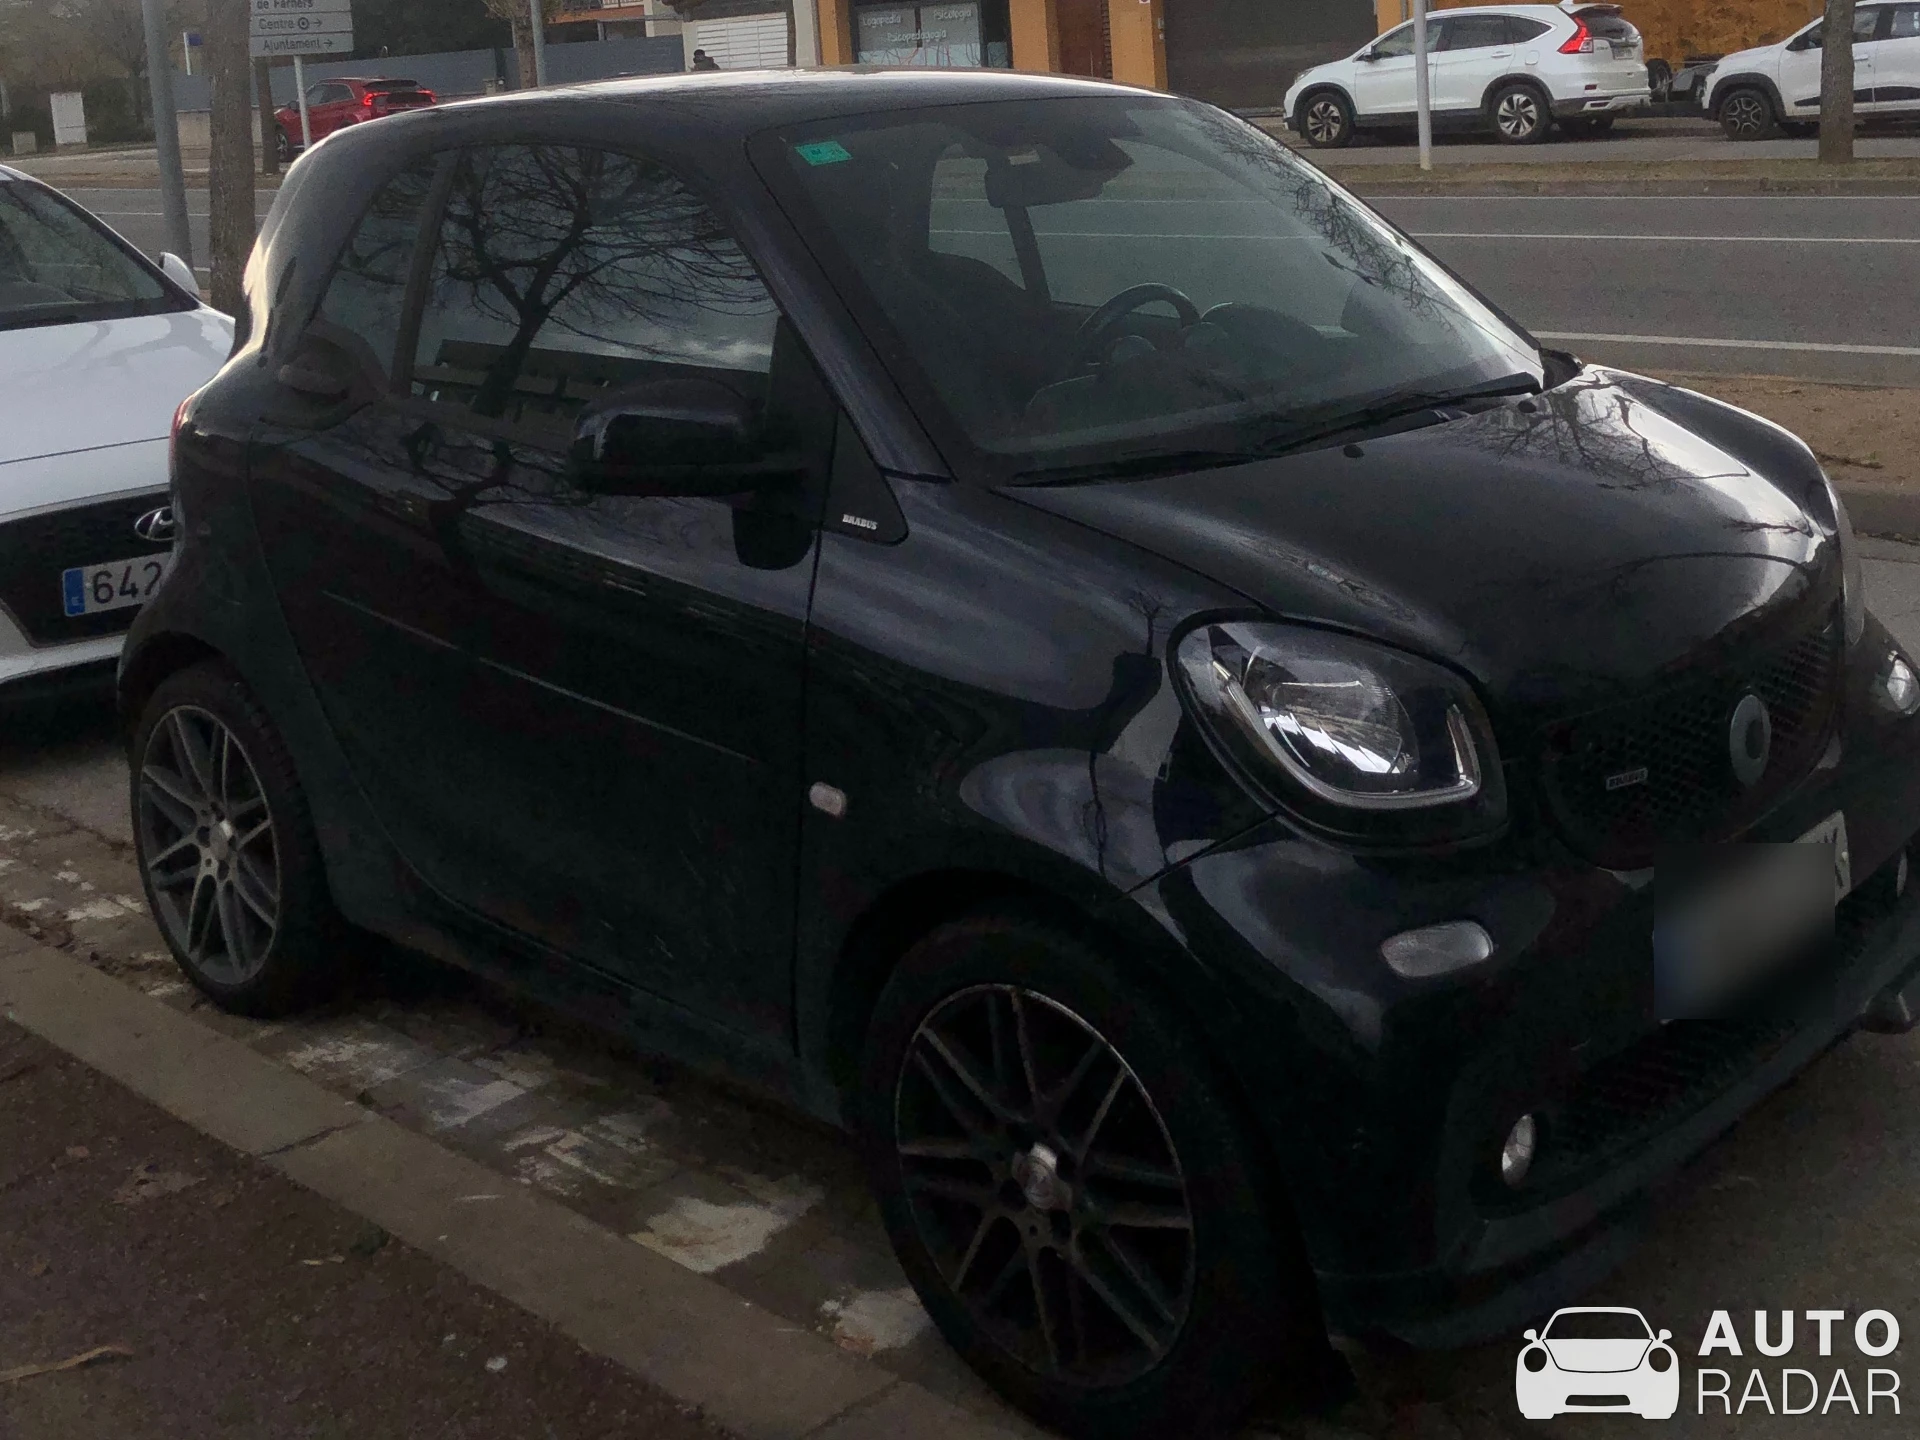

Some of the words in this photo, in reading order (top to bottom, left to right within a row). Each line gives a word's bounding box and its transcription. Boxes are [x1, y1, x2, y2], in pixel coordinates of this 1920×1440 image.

[259, 18, 295, 30] Centre
[263, 38, 320, 53] Ajuntament
[842, 514, 878, 531] BRABUS
